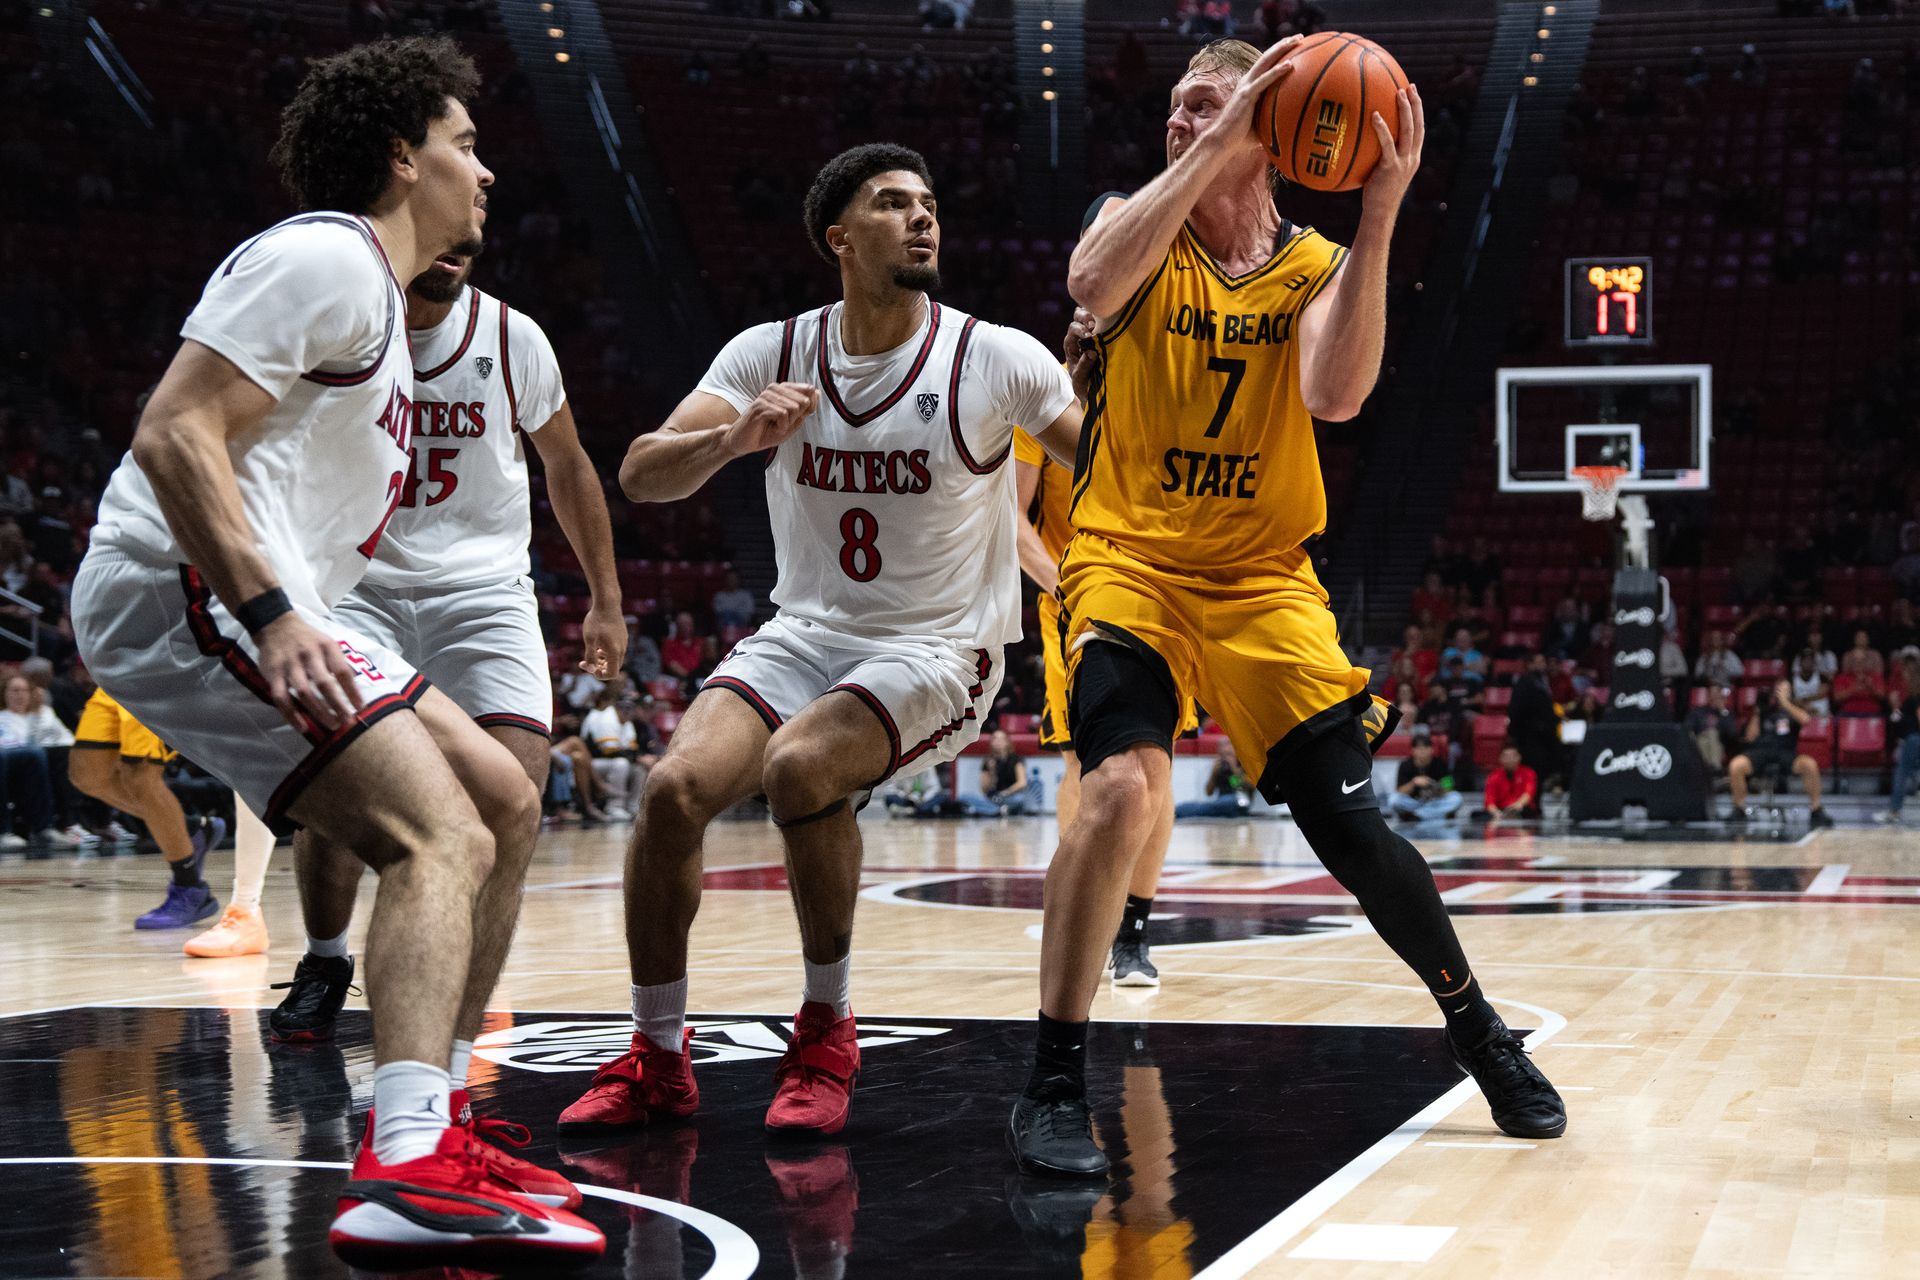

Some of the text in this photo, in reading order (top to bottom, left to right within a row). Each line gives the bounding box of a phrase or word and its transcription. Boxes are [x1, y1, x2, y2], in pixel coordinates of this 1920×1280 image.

[1306, 98, 1344, 177] ELITE
[1588, 266, 1643, 293] 9:42
[1165, 303, 1218, 342] LONG
[1597, 291, 1637, 335] 17
[1203, 356, 1247, 438] 7
[796, 441, 932, 495] AZTECS
[1160, 447, 1260, 499] STATE
[839, 507, 883, 583] 8
